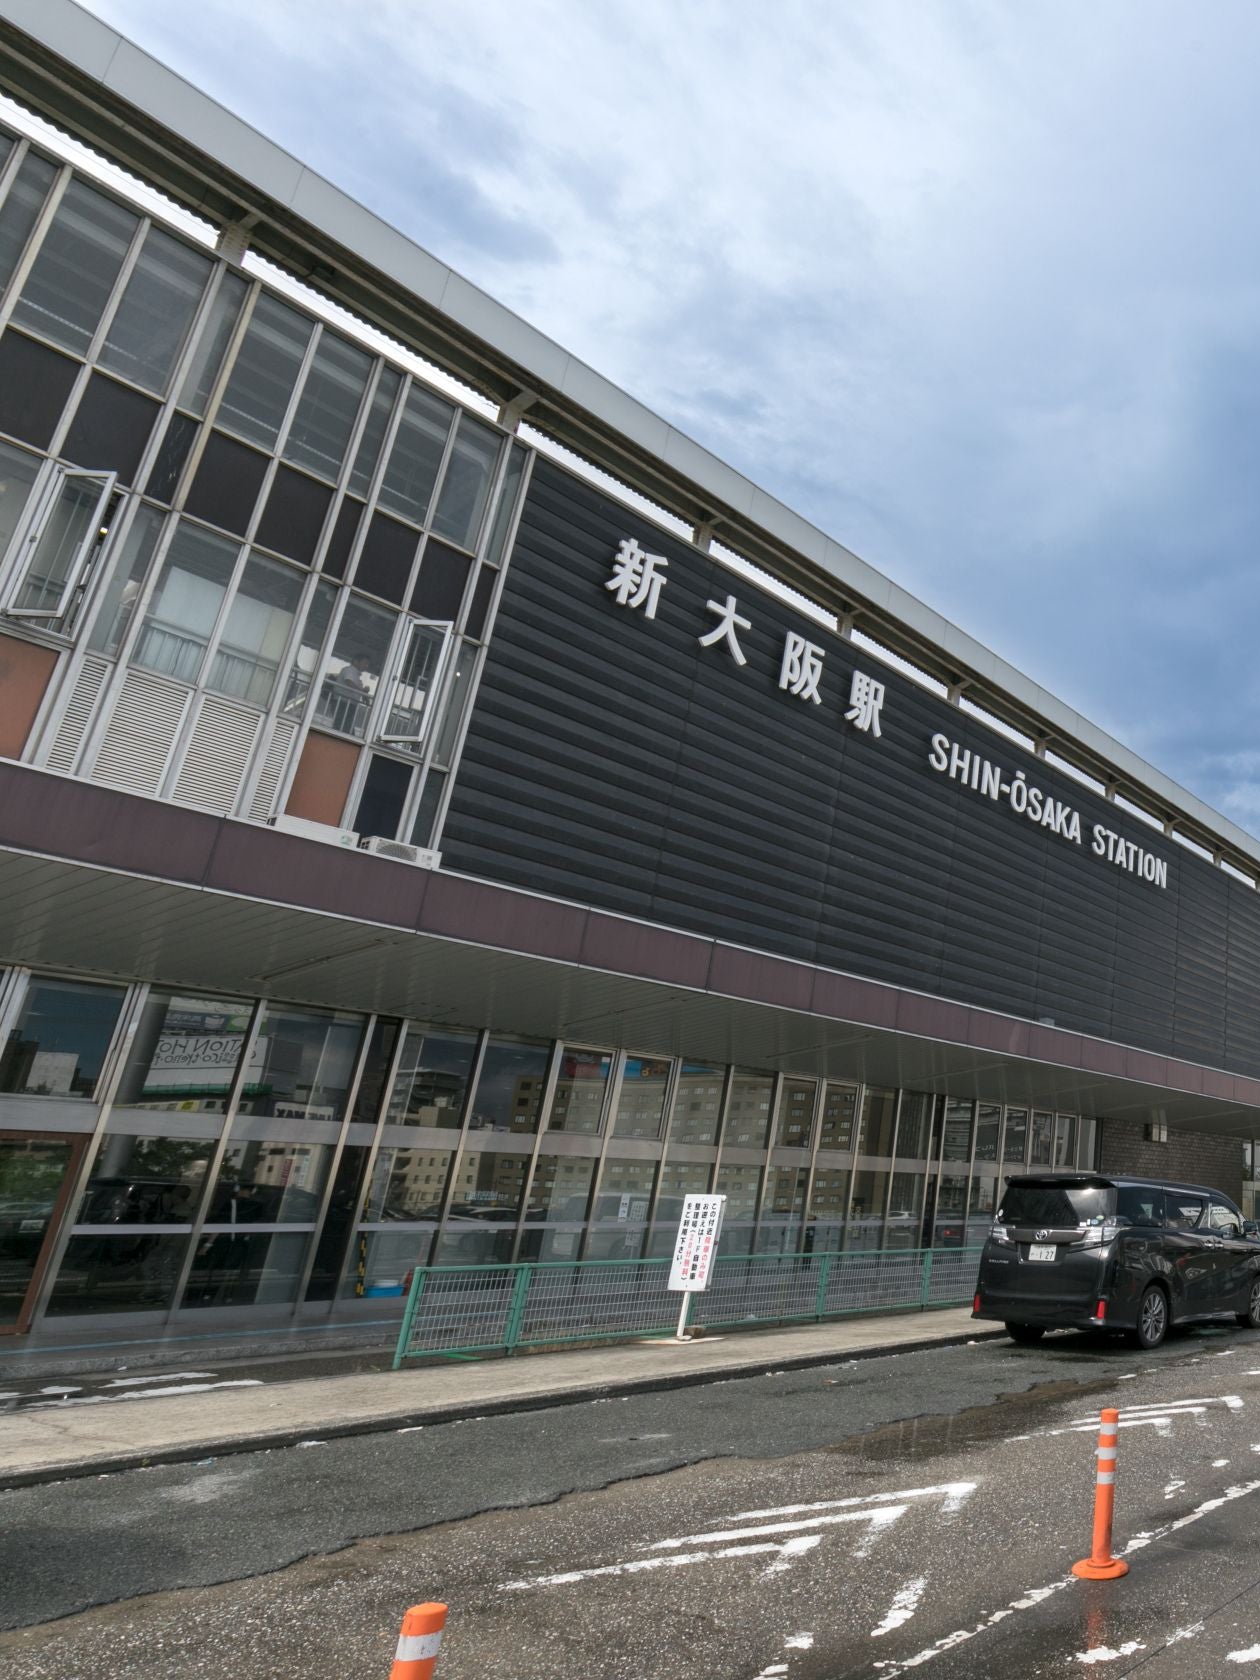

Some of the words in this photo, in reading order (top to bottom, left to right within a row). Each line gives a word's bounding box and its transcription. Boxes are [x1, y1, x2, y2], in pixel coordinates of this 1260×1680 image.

[605, 537, 886, 738] 新大阪駅
[1091, 824, 1168, 889] STATION
